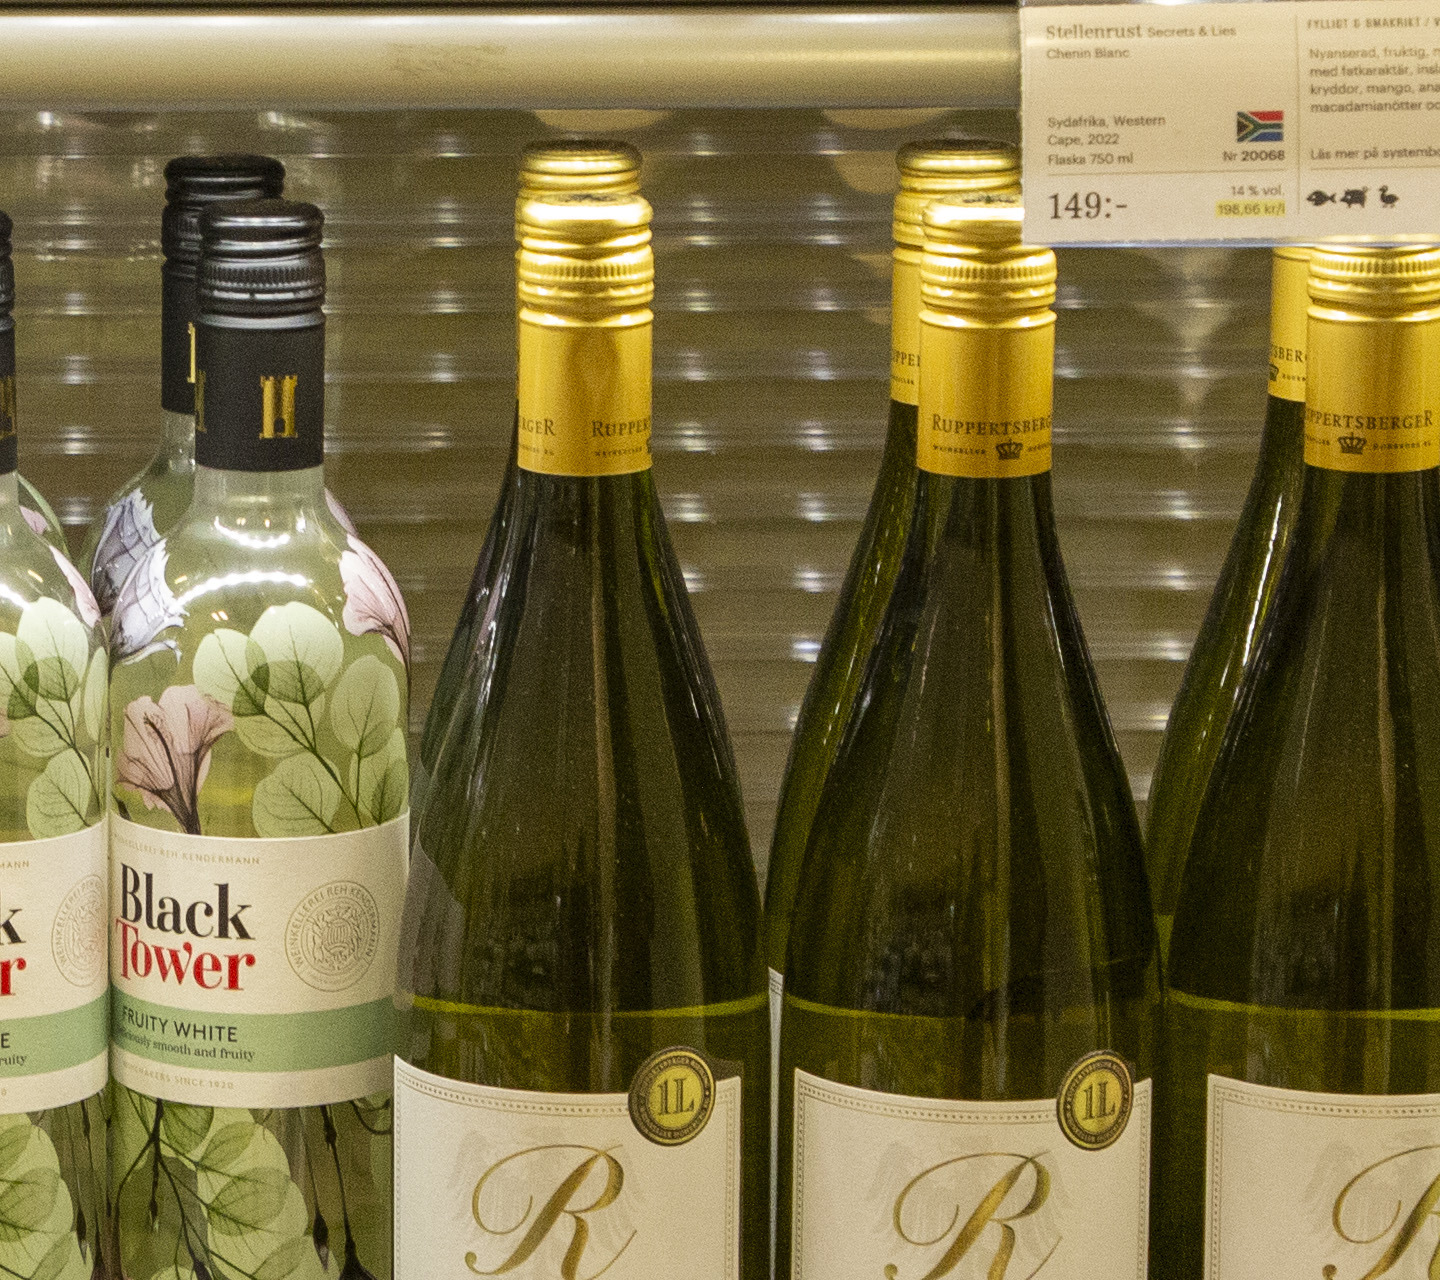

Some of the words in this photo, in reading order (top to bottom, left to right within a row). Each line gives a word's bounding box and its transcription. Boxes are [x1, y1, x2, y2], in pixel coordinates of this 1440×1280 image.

[1046, 23, 1142, 40] Stellenrust
[120, 862, 256, 942] Black
[116, 917, 256, 992] Tower
[174, 1014, 238, 1043] WHITE
